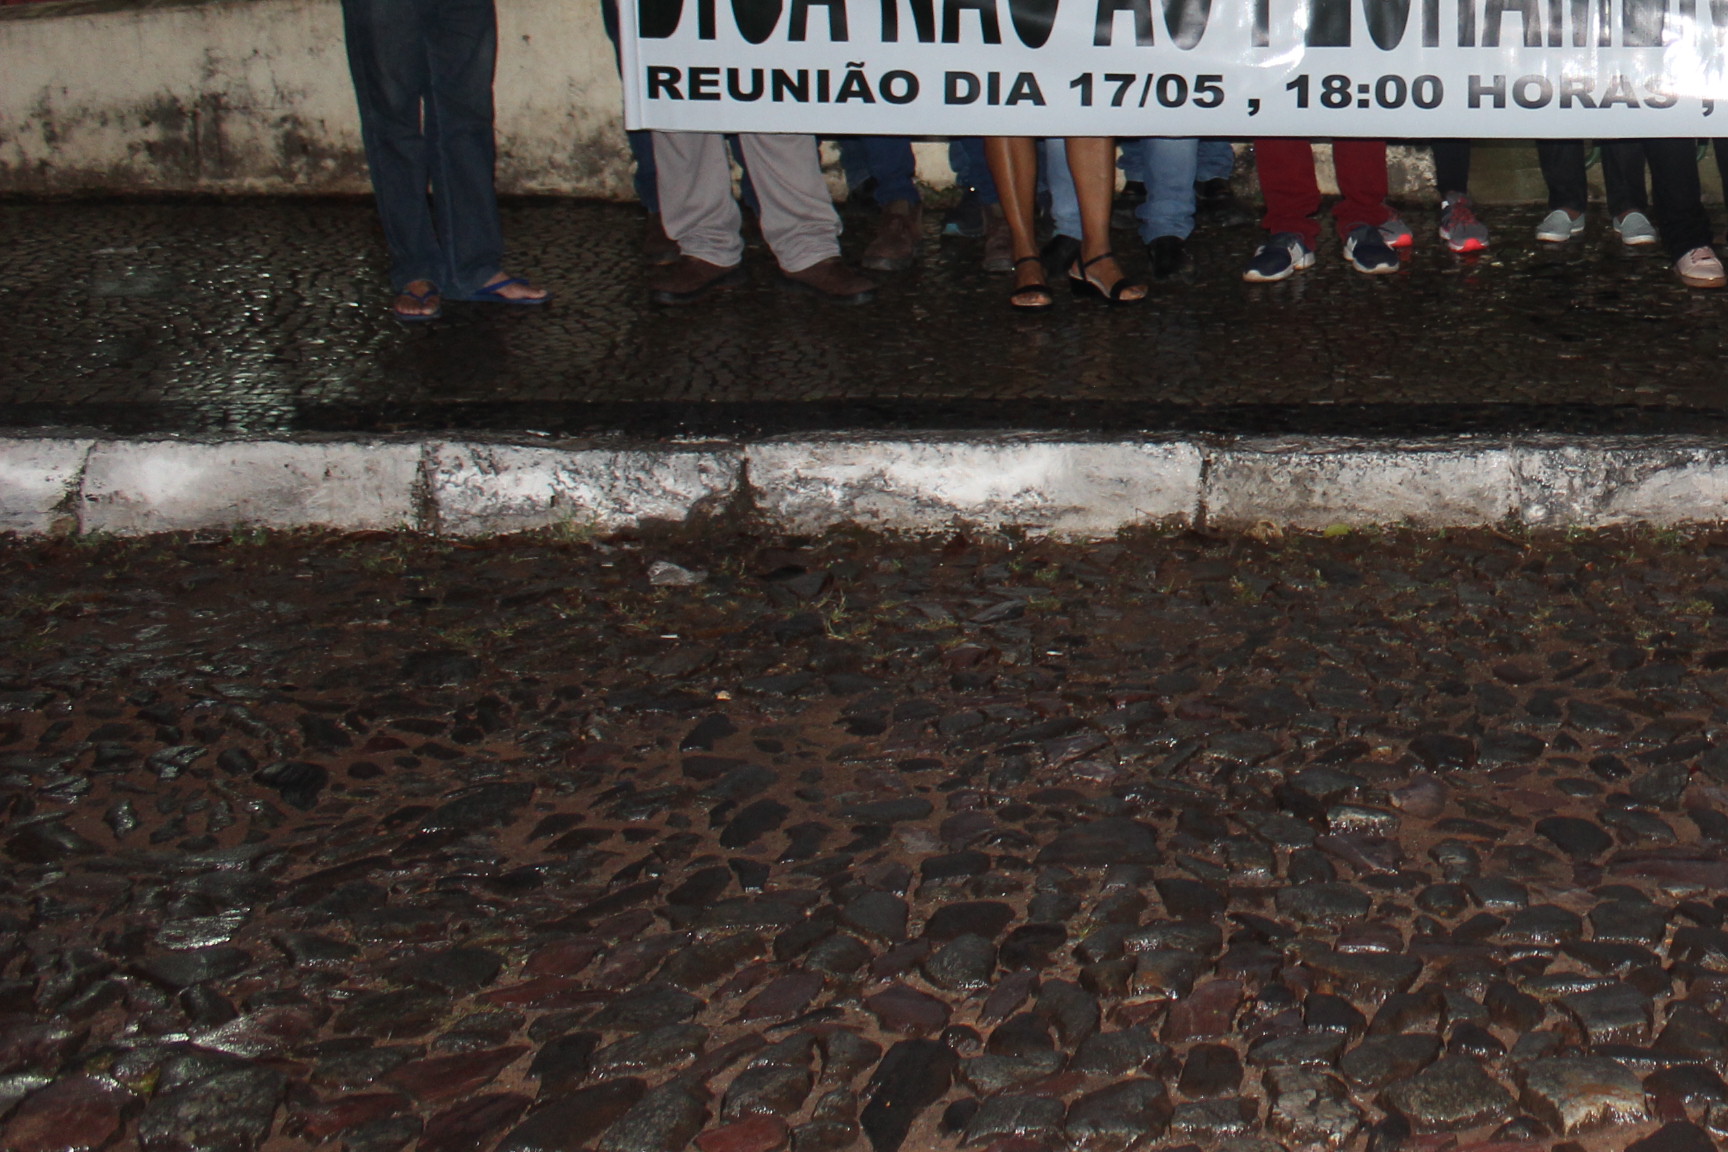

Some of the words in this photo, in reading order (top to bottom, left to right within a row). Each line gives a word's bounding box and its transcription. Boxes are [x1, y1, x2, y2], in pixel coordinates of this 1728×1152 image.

[647, 62, 920, 107] REUNIÃO
[944, 71, 1046, 107] DIA
[1069, 72, 1225, 110] 17/05
[1284, 73, 1445, 110] 18:00
[1467, 73, 1679, 110] HORAS
